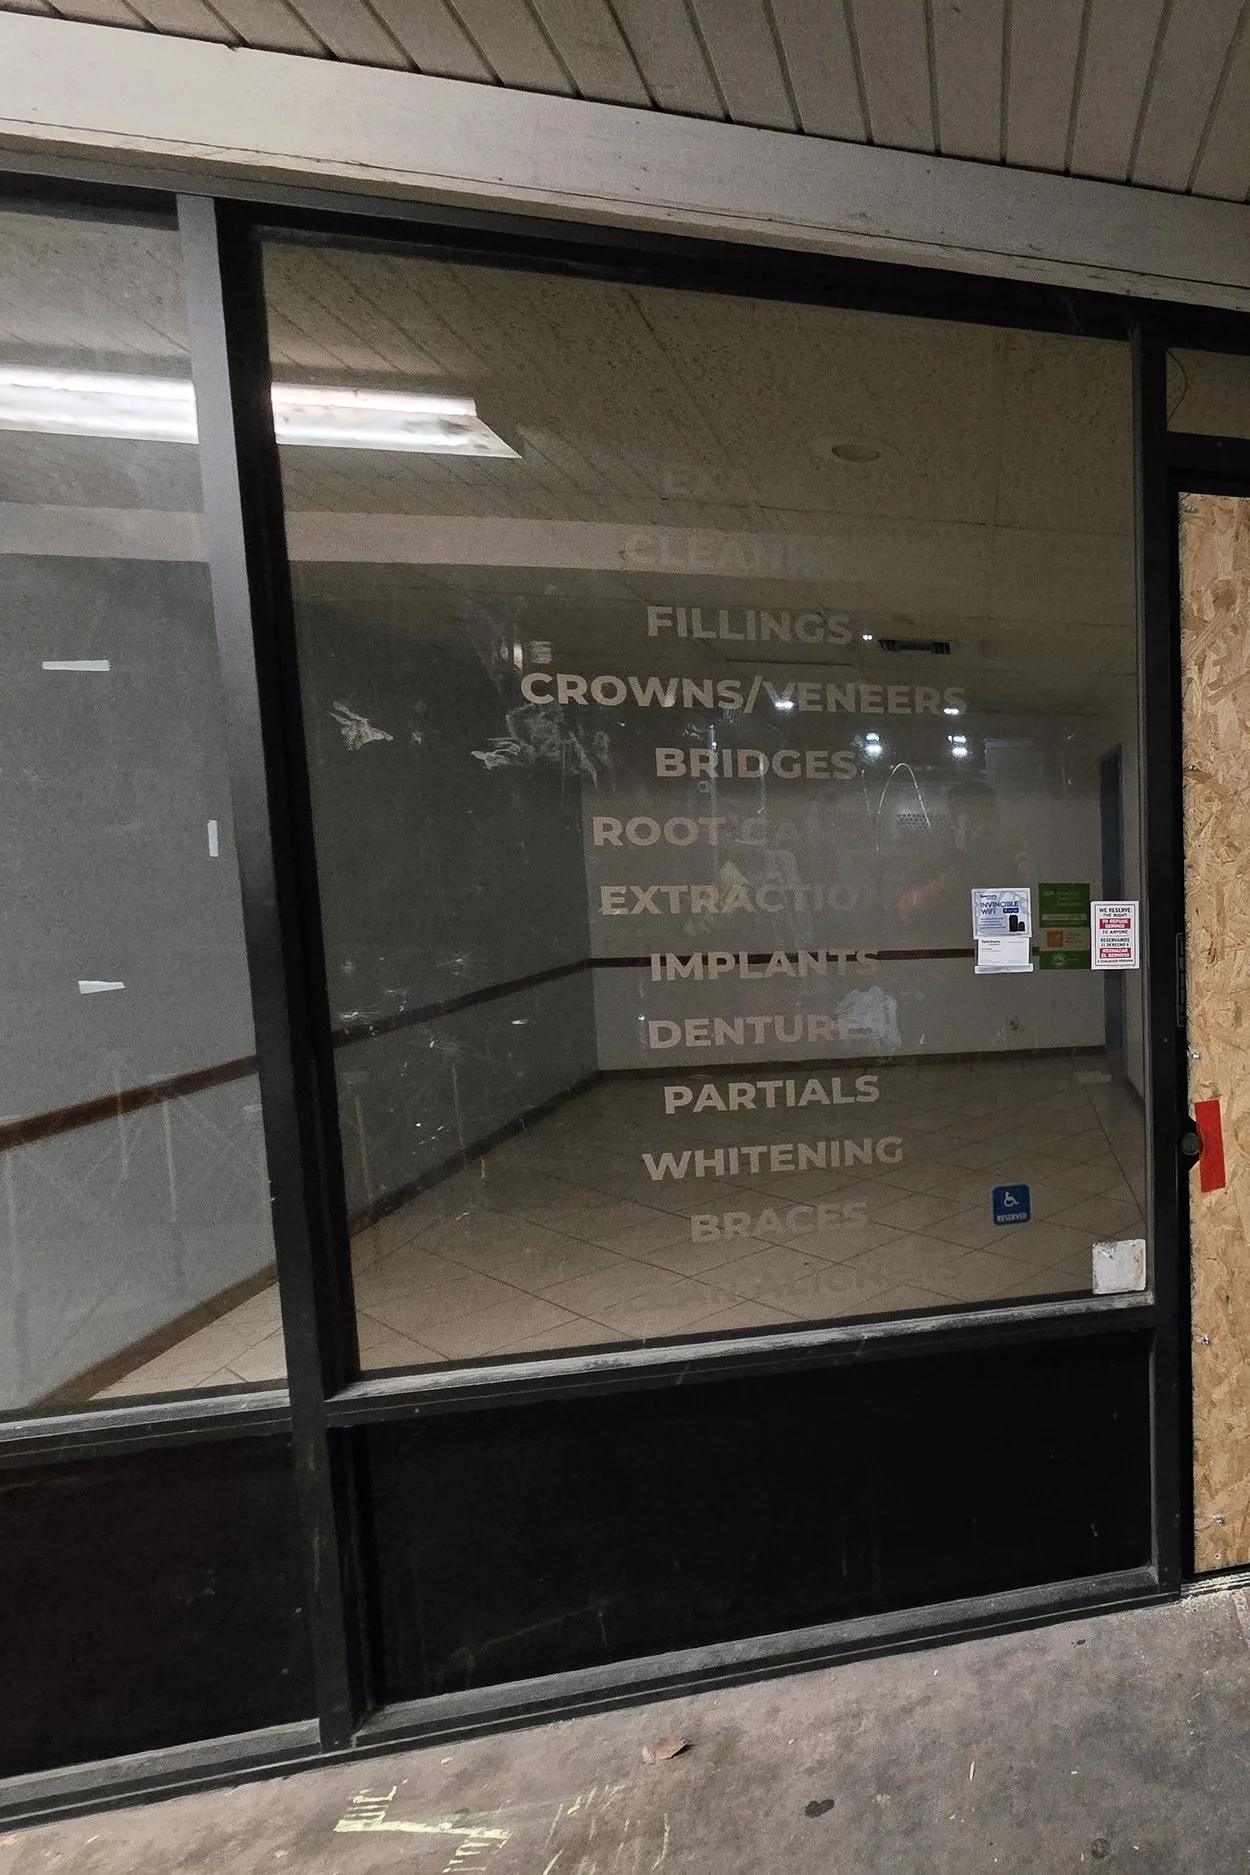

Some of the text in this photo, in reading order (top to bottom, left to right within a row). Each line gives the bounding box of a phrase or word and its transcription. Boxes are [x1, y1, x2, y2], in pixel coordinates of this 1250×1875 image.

[646, 605, 853, 646] FILLINGS
[520, 671, 968, 715] CROWNS/VENEERS
[655, 747, 858, 781] BRIDGES
[592, 816, 725, 846] ROOT
[979, 900, 1020, 908] INVINCIBLE
[650, 948, 881, 982] IMPLANTS
[663, 1074, 881, 1114] PARTIALS
[642, 1136, 904, 1182] WHITENING
[690, 1202, 868, 1242] BRACES
[996, 1212, 1028, 1222] RESERVED
